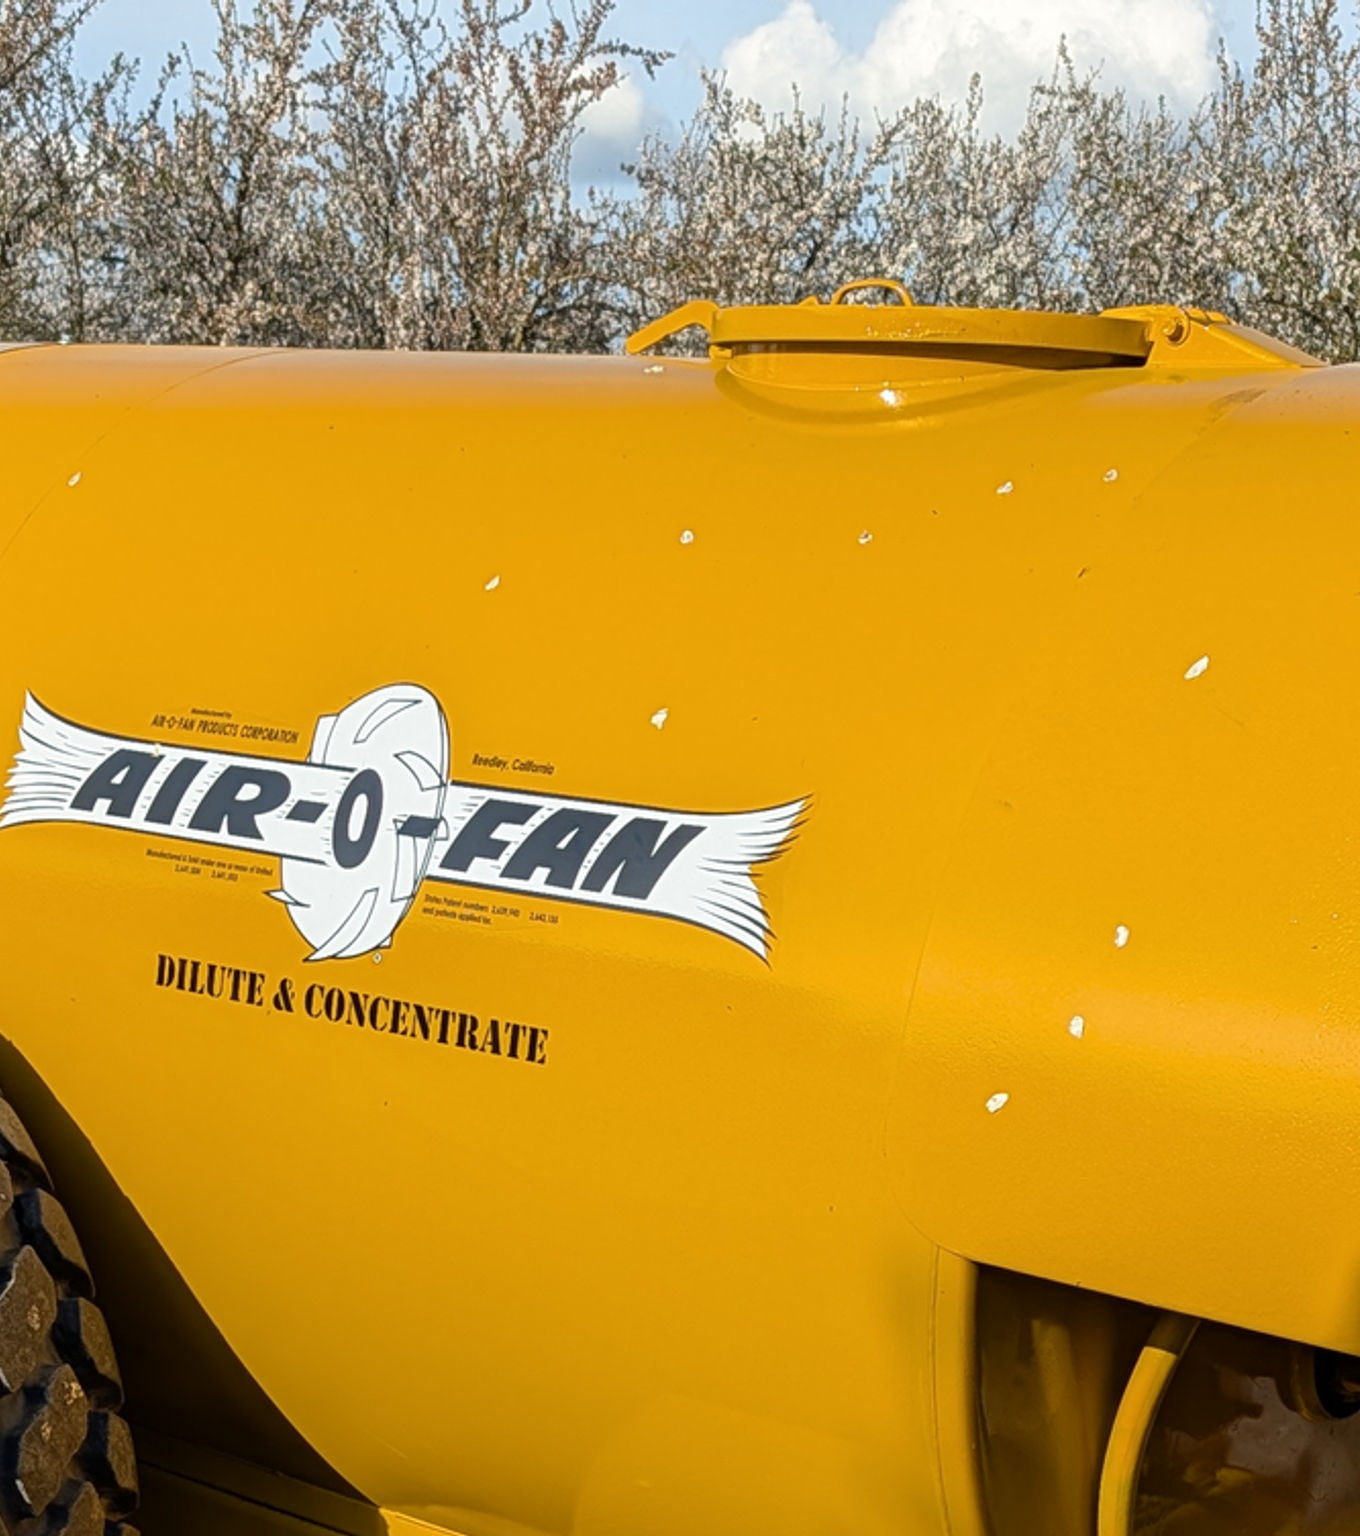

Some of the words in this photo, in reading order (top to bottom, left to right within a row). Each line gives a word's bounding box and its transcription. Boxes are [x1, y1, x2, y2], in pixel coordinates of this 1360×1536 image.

[151, 714, 194, 731] AIR-O-FAN
[196, 719, 239, 738] PRODUCTS
[240, 725, 300, 744] CORPORATION
[512, 758, 554, 775] California
[70, 749, 706, 899] AIR-O-FAN
[155, 953, 266, 1007] DILUTE
[272, 977, 295, 1014] &
[304, 982, 549, 1066] CONCENTRATE
